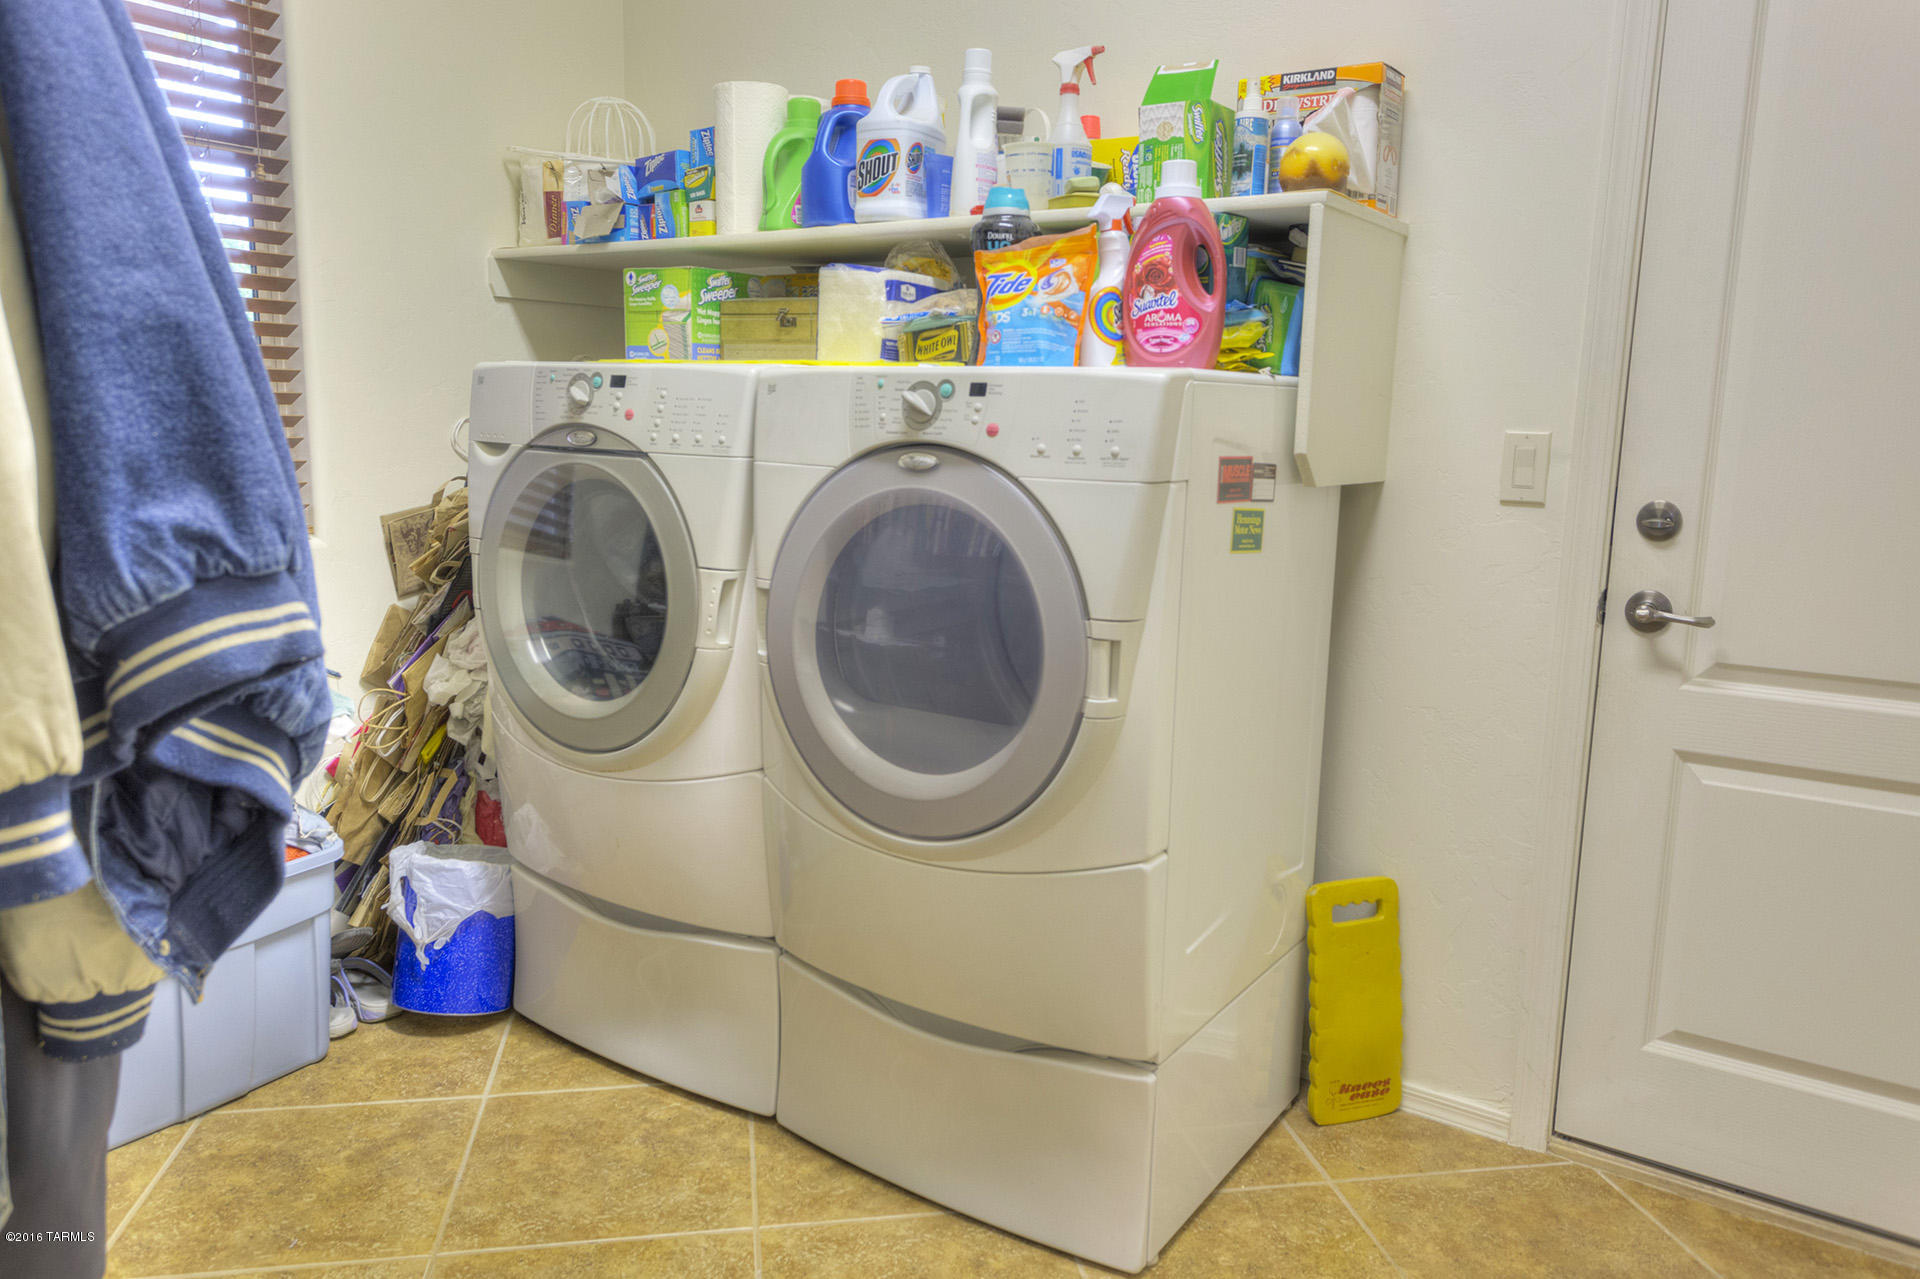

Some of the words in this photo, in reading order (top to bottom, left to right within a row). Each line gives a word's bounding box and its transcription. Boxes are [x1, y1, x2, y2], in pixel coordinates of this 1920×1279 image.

[1283, 70, 1335, 84] KIRKLAND
[1192, 105, 1204, 142] Swiffer
[701, 129, 714, 157] Ziploc
[857, 152, 899, 190] SHOUT
[550, 194, 561, 232] Dinner
[987, 232, 1014, 241] Downy
[698, 287, 738, 306] Sweeper
[986, 273, 1033, 303] Tide
[1132, 290, 1177, 317] Suavitel
[1144, 312, 1182, 322] AROMA
[918, 339, 939, 355] WHITE
